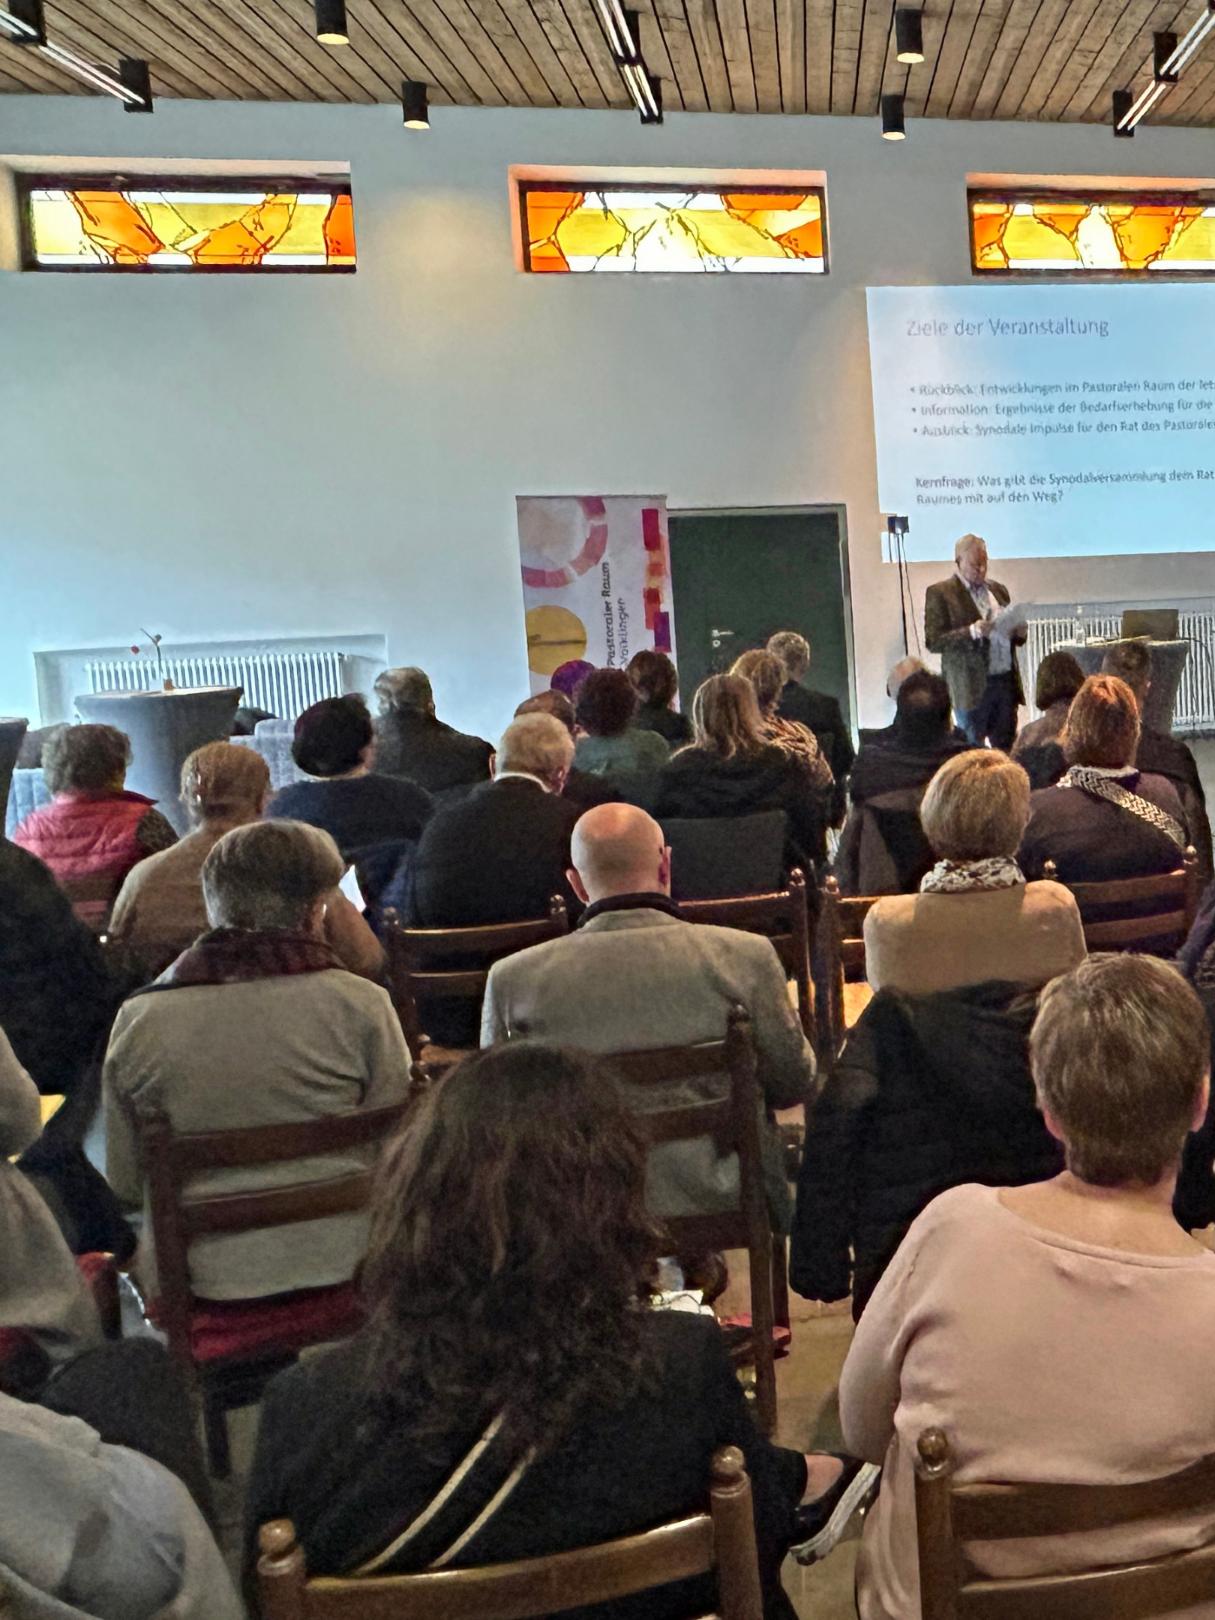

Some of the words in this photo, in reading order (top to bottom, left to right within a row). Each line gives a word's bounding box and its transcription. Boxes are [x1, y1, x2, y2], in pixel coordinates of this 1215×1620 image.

[906, 318, 949, 336] Ziele
[954, 318, 984, 336] der
[988, 317, 1110, 338] Veranstaltung
[1065, 381, 1079, 393] im
[1082, 379, 1140, 393] Pastoralen
[1143, 379, 1175, 391] Raum
[1177, 379, 1195, 391] der
[995, 402, 1054, 417] Ergebnisse
[1057, 402, 1076, 414] der
[1177, 397, 1193, 411] für
[1196, 398, 1213, 410] die
[975, 422, 1027, 437] Synodale
[1030, 421, 1074, 436] Impulse
[1077, 421, 1093, 433] für
[1096, 419, 1118, 432] den
[1120, 419, 1138, 432] Rat
[1141, 419, 1160, 431] des
[976, 475, 1001, 487] Was
[1004, 474, 1026, 488] gibt
[1029, 474, 1046, 486] die
[1197, 469, 1214, 480] Rat
[965, 493, 984, 504] mit
[986, 491, 1006, 504] auf
[1008, 491, 1030, 503] den
[1032, 490, 1064, 504] Weg?
[601, 562, 611, 598] Raum
[604, 600, 615, 667] Pastoraler
